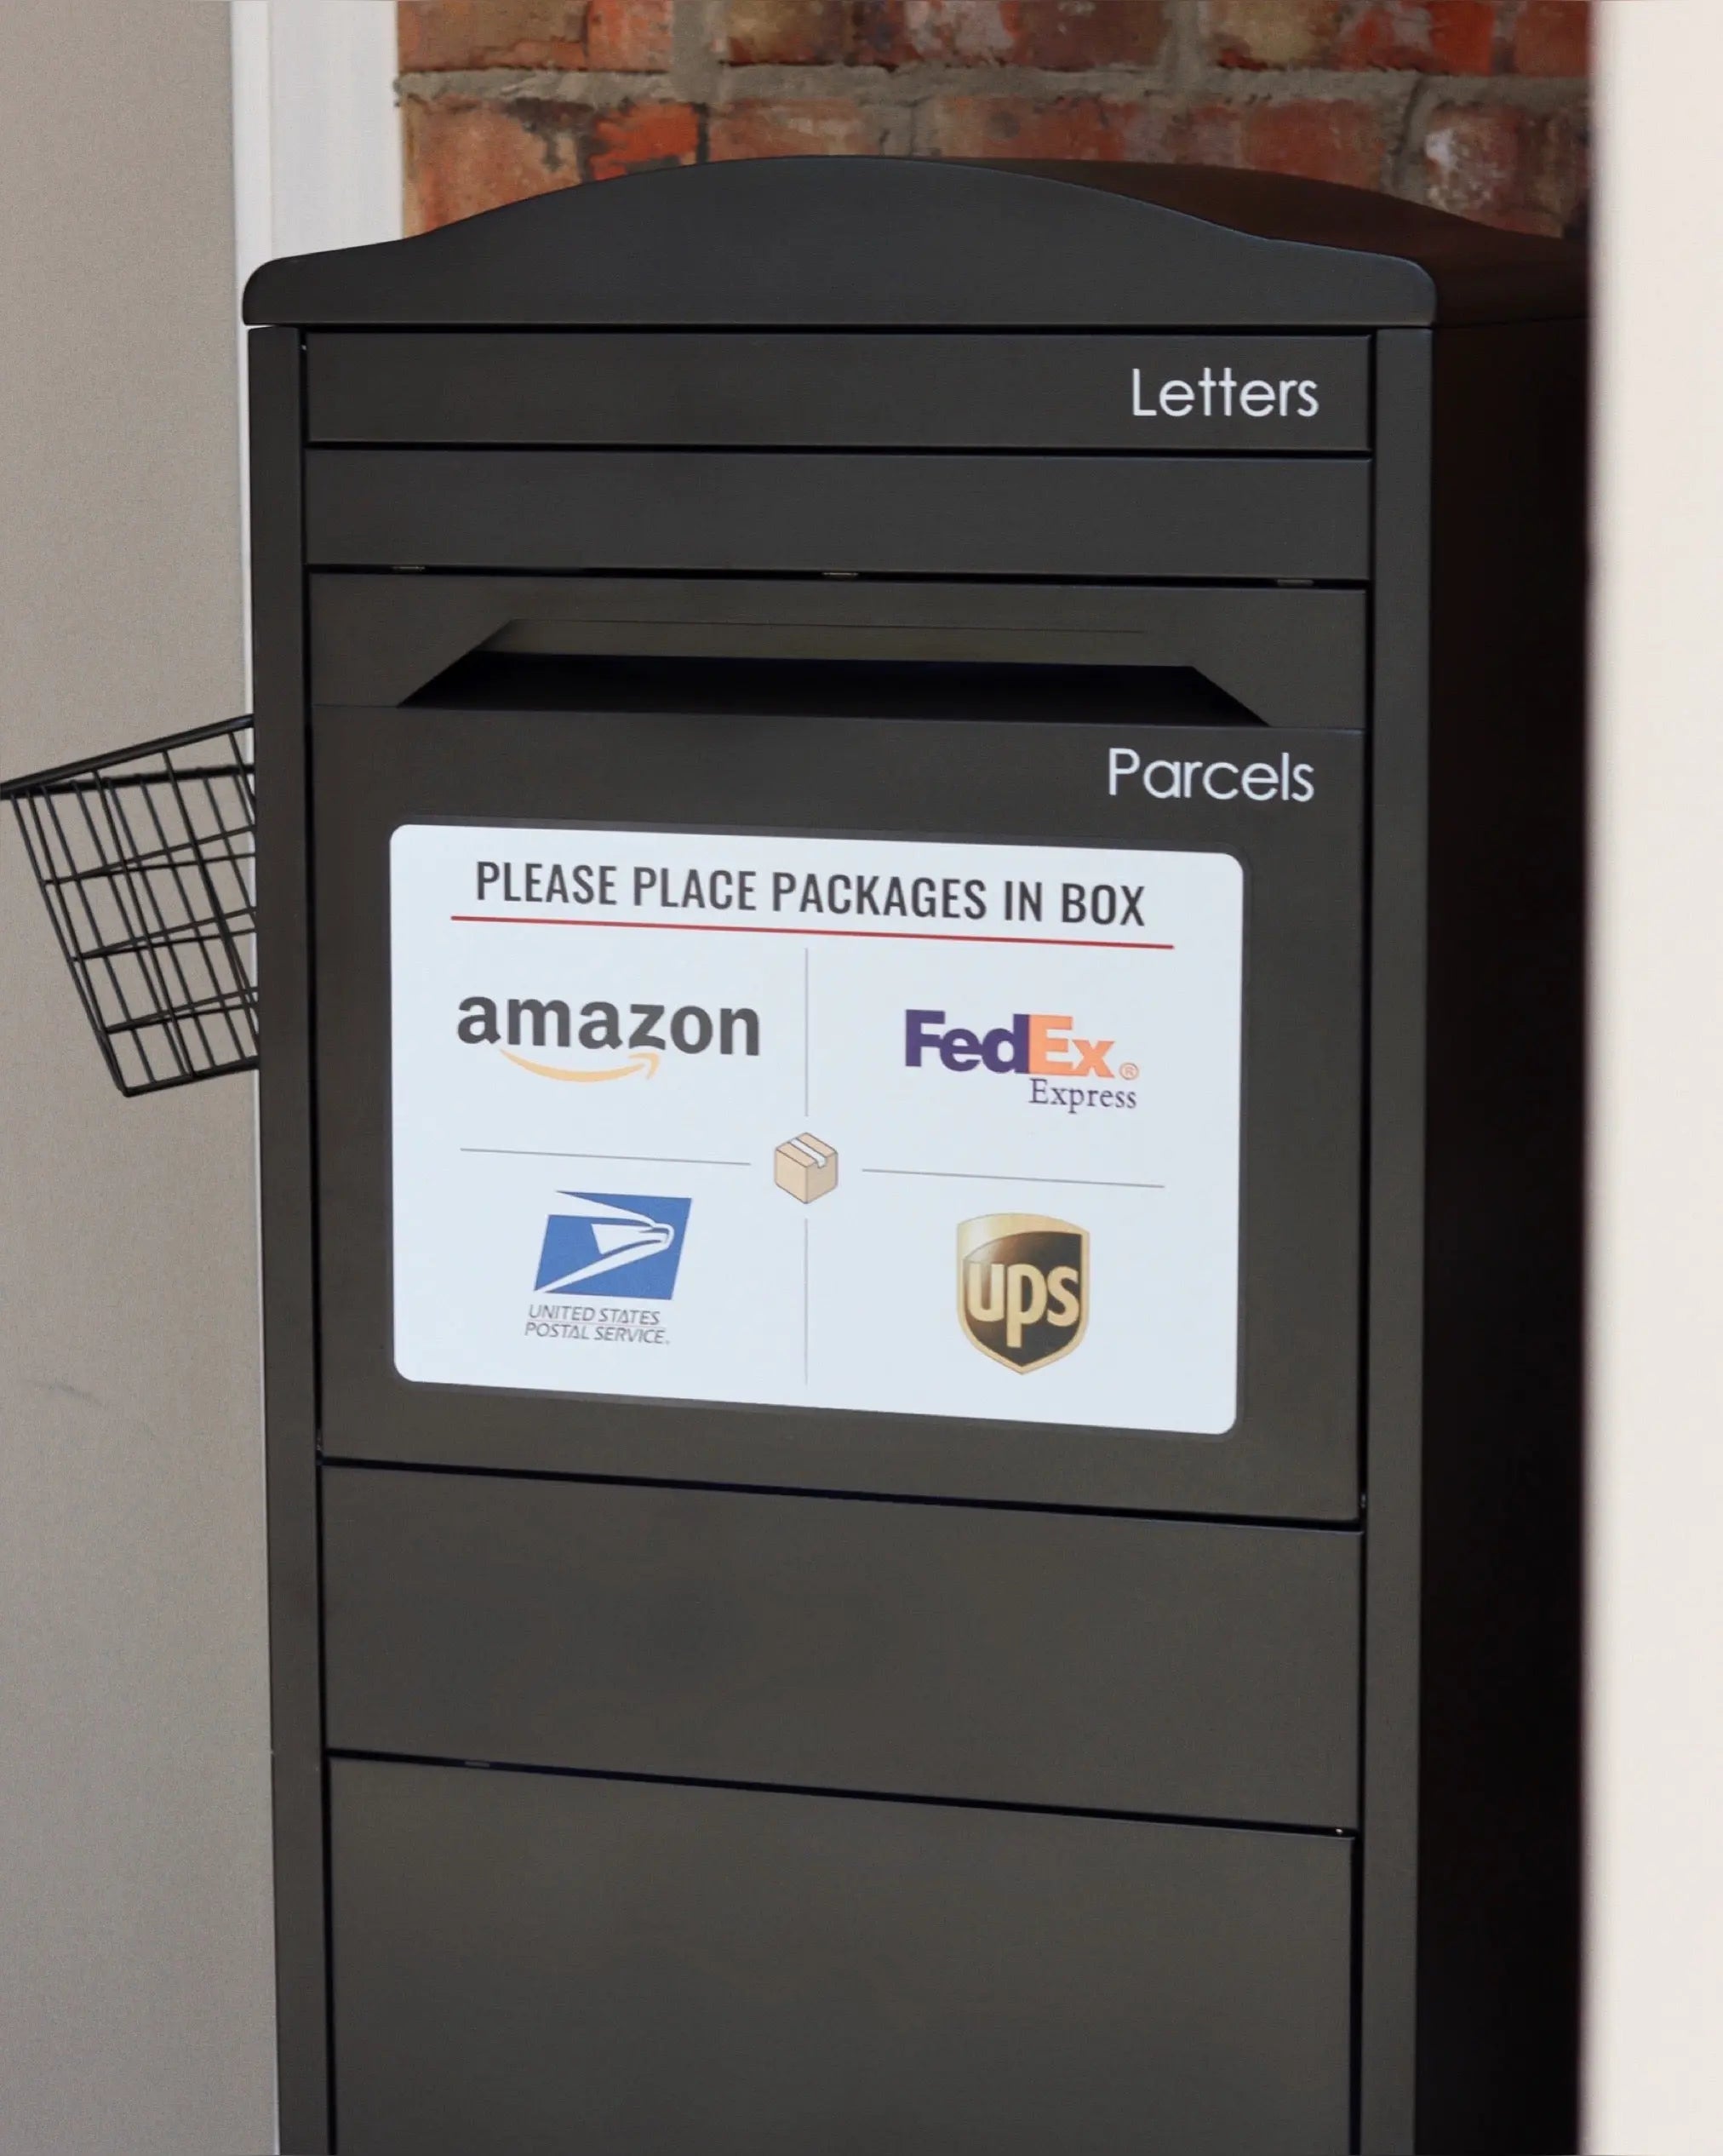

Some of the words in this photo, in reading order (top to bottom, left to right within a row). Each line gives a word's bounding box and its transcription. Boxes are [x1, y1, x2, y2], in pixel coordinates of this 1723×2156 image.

[1132, 367, 1319, 417] Letters
[1108, 747, 1315, 803] Parcels
[478, 861, 616, 905] PLEASE
[634, 867, 756, 910] PLACE
[773, 872, 987, 920] PACKAGES
[1005, 880, 1042, 922] IN
[1062, 883, 1145, 926] BOX
[456, 996, 759, 1057] amazon
[1028, 1077, 1137, 1114] Express
[524, 1321, 590, 1340] POSTAL
[528, 1304, 595, 1322] UNITED
[598, 1307, 661, 1326] STATES
[967, 1263, 1079, 1348] ups
